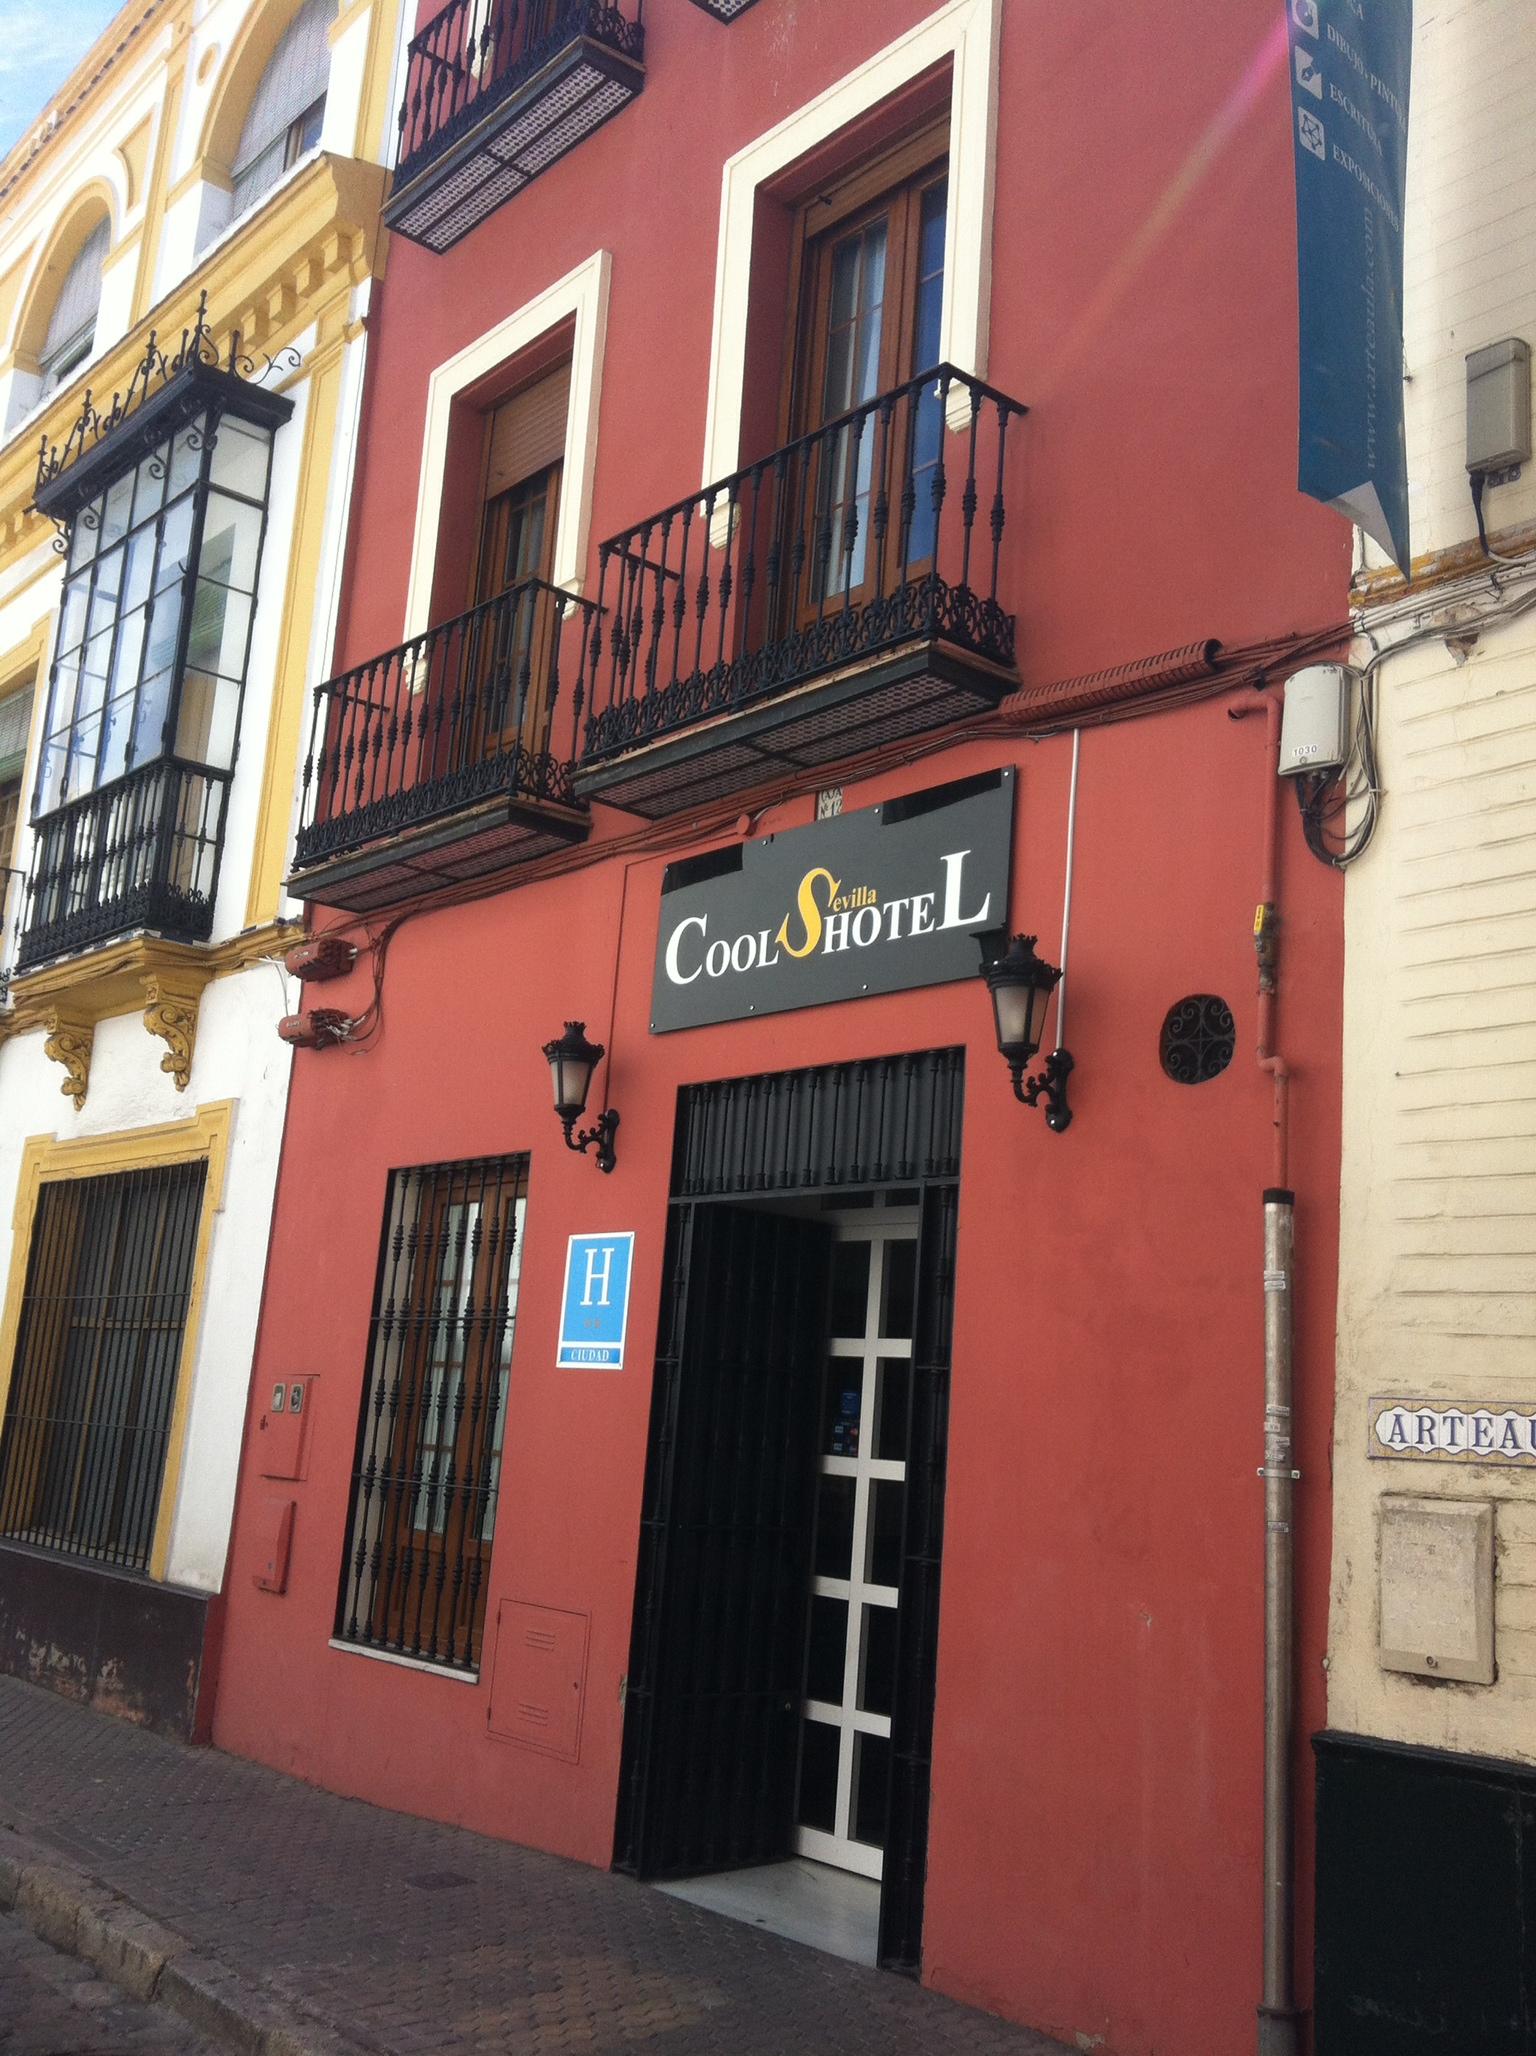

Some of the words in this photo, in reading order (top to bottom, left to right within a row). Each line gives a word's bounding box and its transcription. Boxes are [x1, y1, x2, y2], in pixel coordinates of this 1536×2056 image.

[1293, 744, 1318, 756] 1030
[579, 1247, 615, 1306] H
[570, 1348, 610, 1362] CIUDAD
